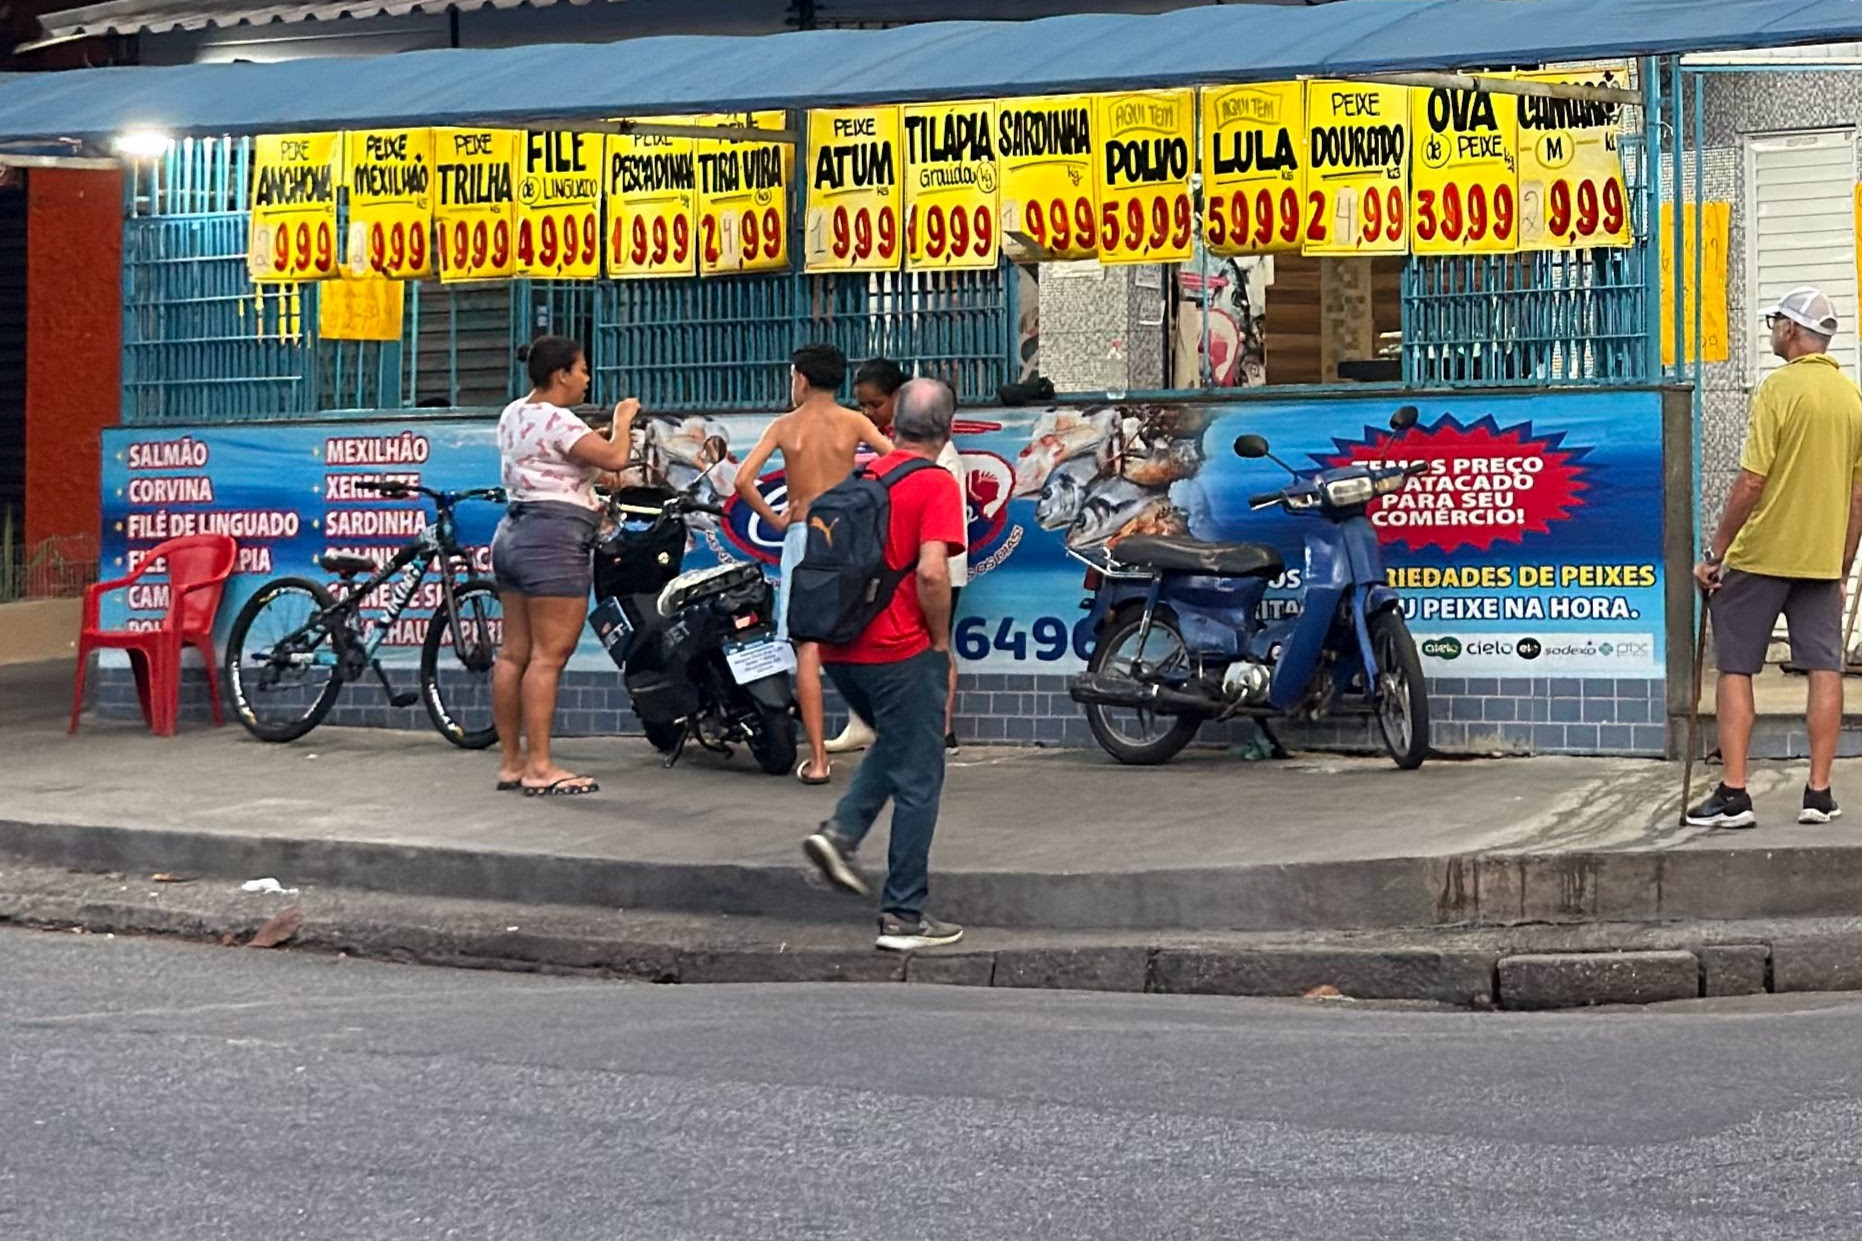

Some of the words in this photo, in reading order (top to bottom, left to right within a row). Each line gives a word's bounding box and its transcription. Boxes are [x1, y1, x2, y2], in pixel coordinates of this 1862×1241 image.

[1116, 103, 1146, 128] AQUI
[1149, 104, 1174, 127] TEM
[1222, 96, 1249, 120] AQUI
[1251, 97, 1274, 119] TEM
[1332, 92, 1380, 116] PEIXE
[1428, 87, 1498, 133] OVA
[834, 118, 876, 137] PEIXE
[905, 108, 996, 164] TILÁPIA
[999, 108, 1091, 157] SARDINHA
[281, 140, 309, 160] PEIXE
[367, 134, 407, 160] PEIXE
[454, 133, 492, 156] PEIXE
[1214, 127, 1298, 174] LULA
[1311, 124, 1404, 168] DOURADO
[1426, 133, 1441, 160] de
[1458, 135, 1502, 159] PEIXE
[1546, 137, 1563, 161] M
[814, 141, 895, 189] ATUM
[1106, 137, 1188, 185] POLVO
[256, 164, 333, 206] ANCHOVA
[437, 162, 513, 205] TRILHA
[129, 438, 207, 467] SALMÃO
[327, 432, 428, 463] MEXILHÃO
[1453, 456, 1544, 478] PREÇO
[129, 478, 213, 502] CORVINA
[1404, 475, 1534, 491] ATACADO
[1382, 493, 1453, 509] PARA
[1462, 492, 1514, 509] SEU
[128, 510, 168, 538] FILÉ
[171, 514, 196, 537] DE
[199, 512, 299, 537] LINGUADO
[326, 511, 426, 535] SARDINHA
[1371, 508, 1525, 526] COMÉRCIO!
[1519, 566, 1555, 587] DE
[1561, 565, 1656, 587] PEIXES
[1423, 597, 1499, 619] PEIXE
[1504, 598, 1544, 619] NA
[1551, 597, 1640, 619] HORA.
[1466, 639, 1513, 656] cielo
[1545, 641, 1598, 656] sodexo
